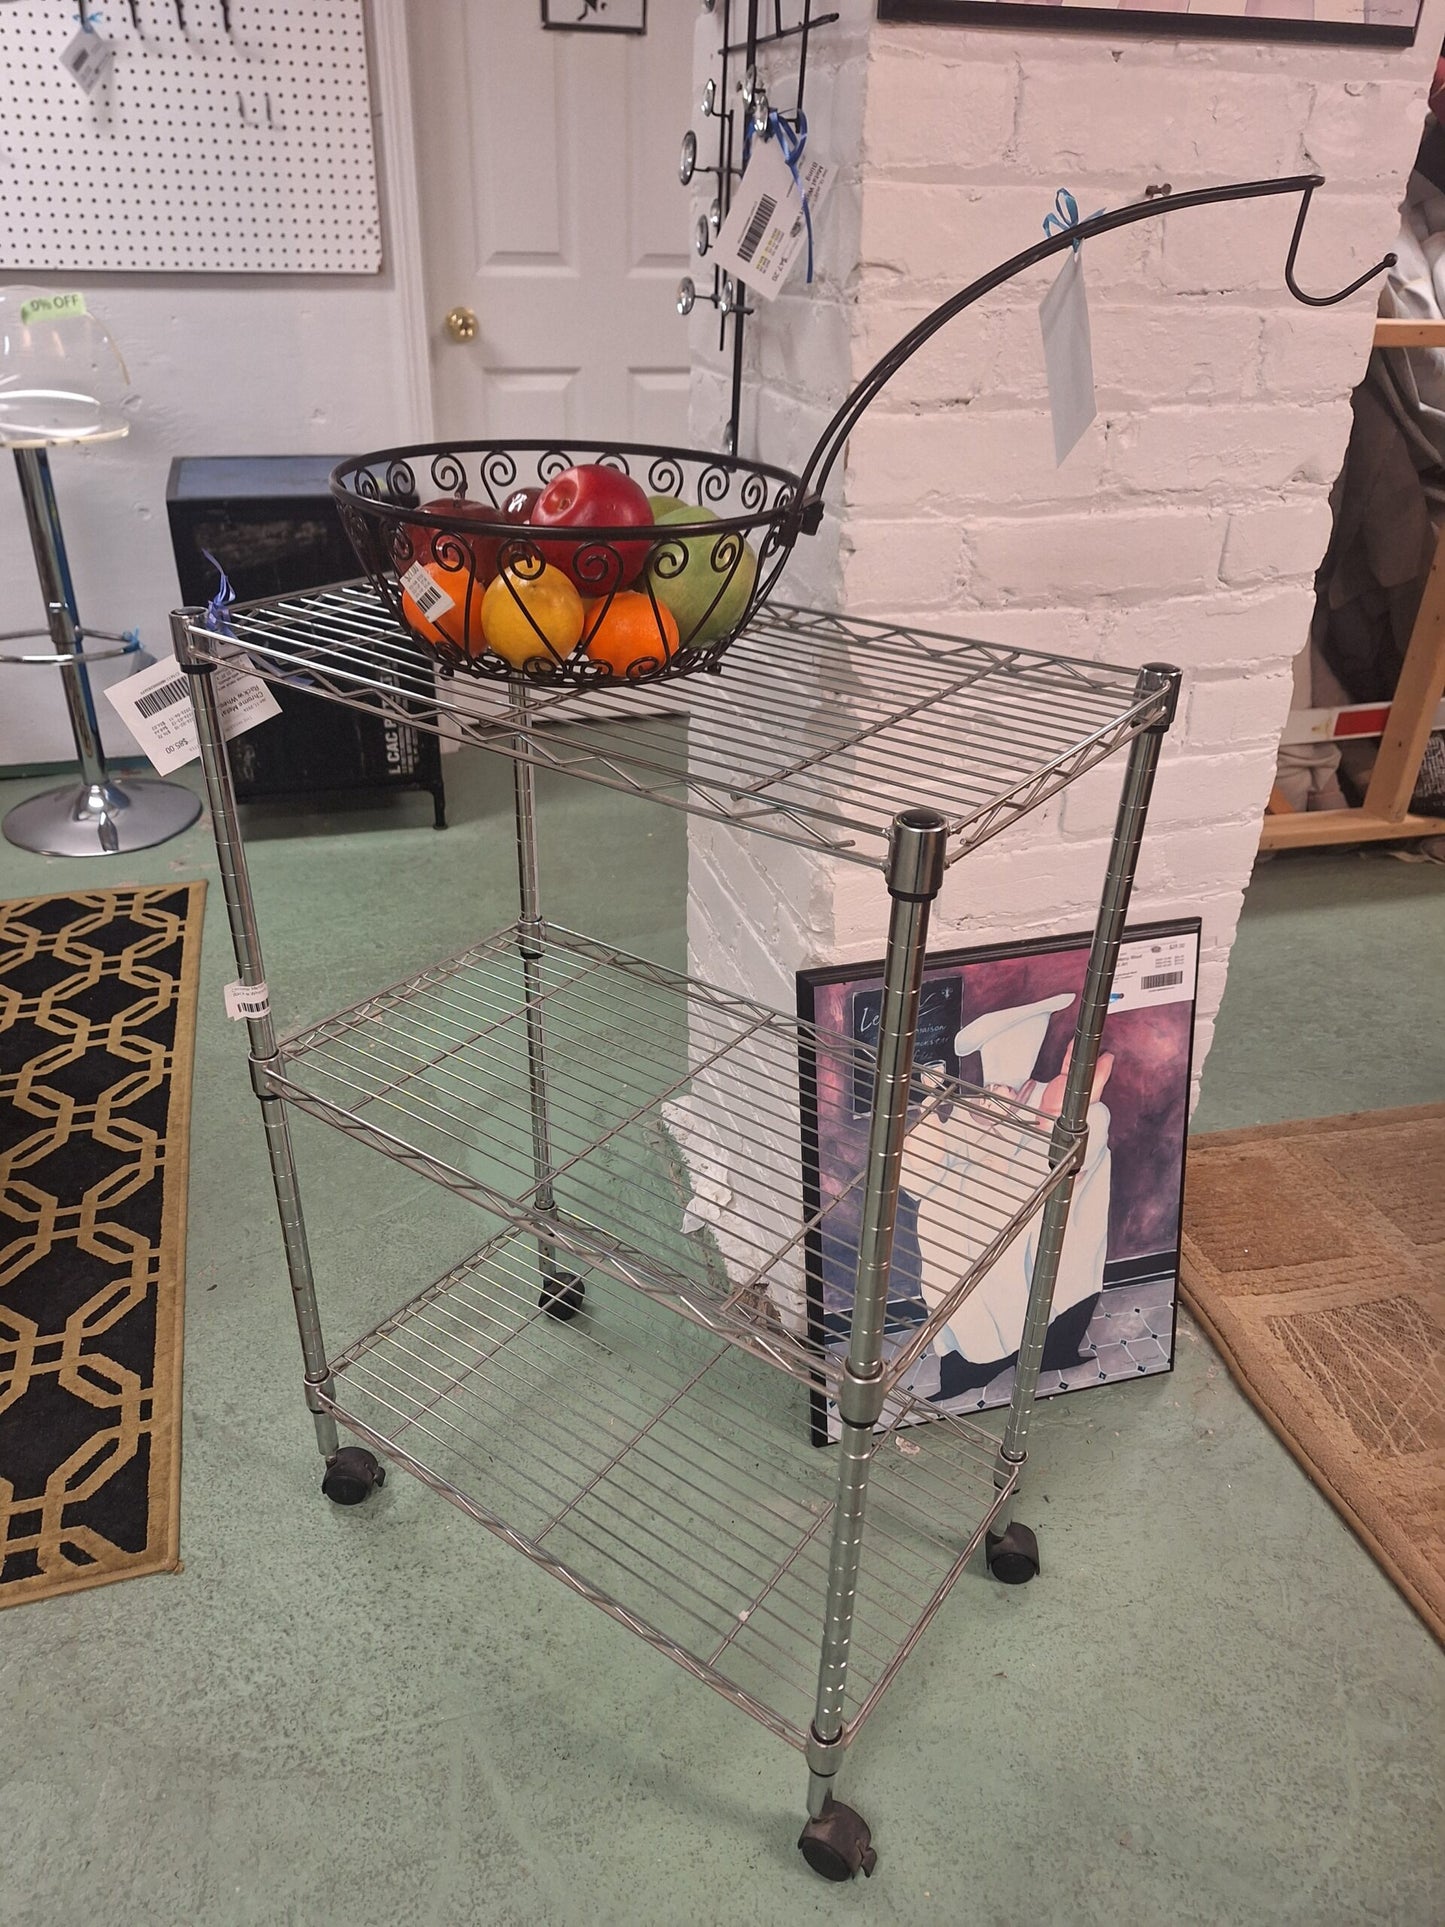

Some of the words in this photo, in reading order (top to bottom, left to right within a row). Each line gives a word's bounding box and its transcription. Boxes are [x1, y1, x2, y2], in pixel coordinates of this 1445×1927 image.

[53, 294, 79, 309] OFF
[243, 684, 259, 696] Rack
[238, 690, 263, 707] Chrome
[220, 704, 238, 717] Metal
[165, 738, 189, 754] $85.00
